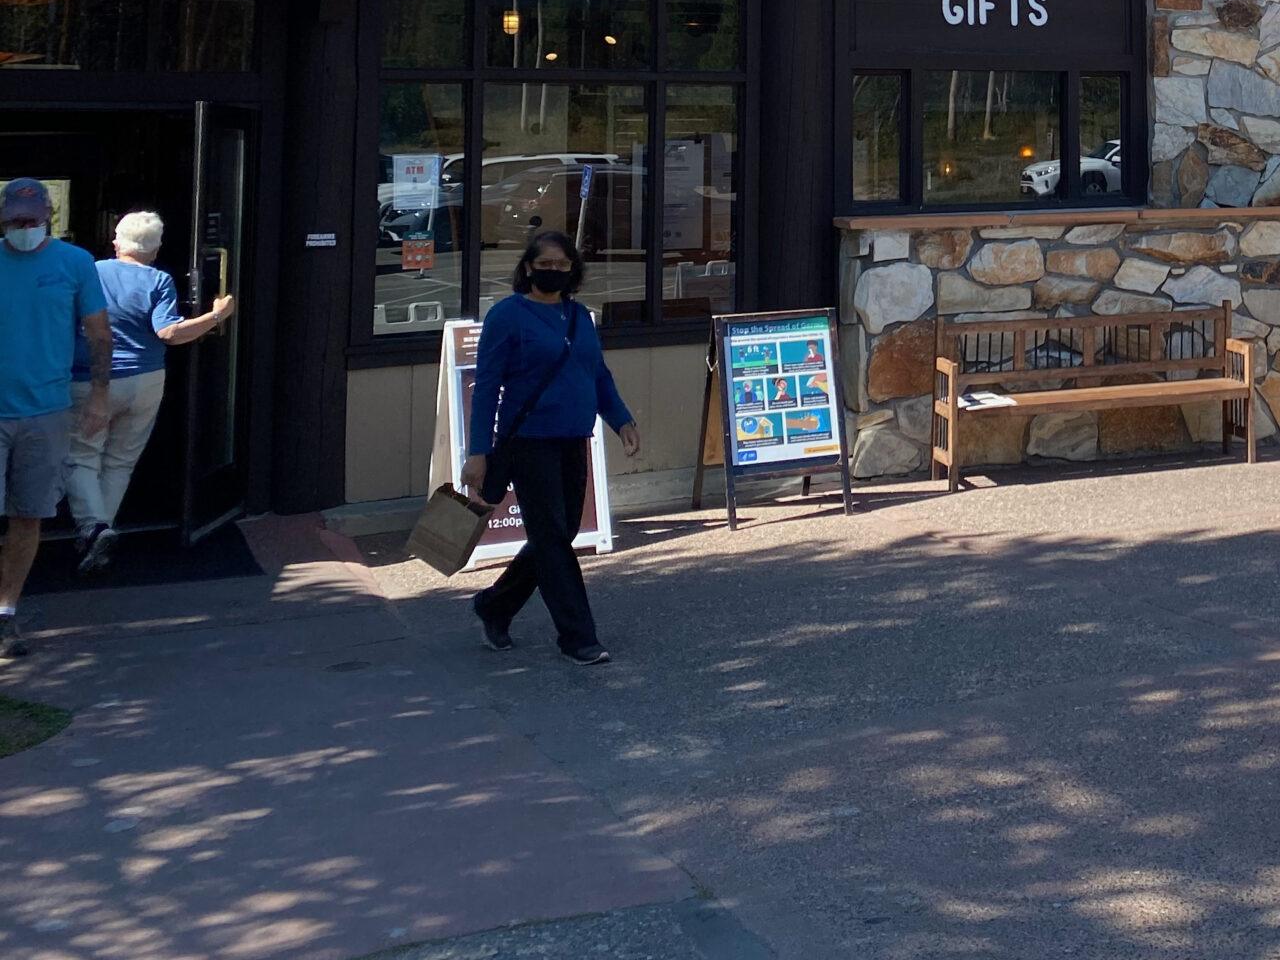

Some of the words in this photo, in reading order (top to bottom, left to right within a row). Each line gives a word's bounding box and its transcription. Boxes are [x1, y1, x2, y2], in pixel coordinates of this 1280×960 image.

[405, 166, 424, 175] ATM
[732, 326, 749, 335] Stop
[750, 325, 764, 333] the
[765, 323, 791, 333] Spread
[488, 517, 523, 528] 12:00p
